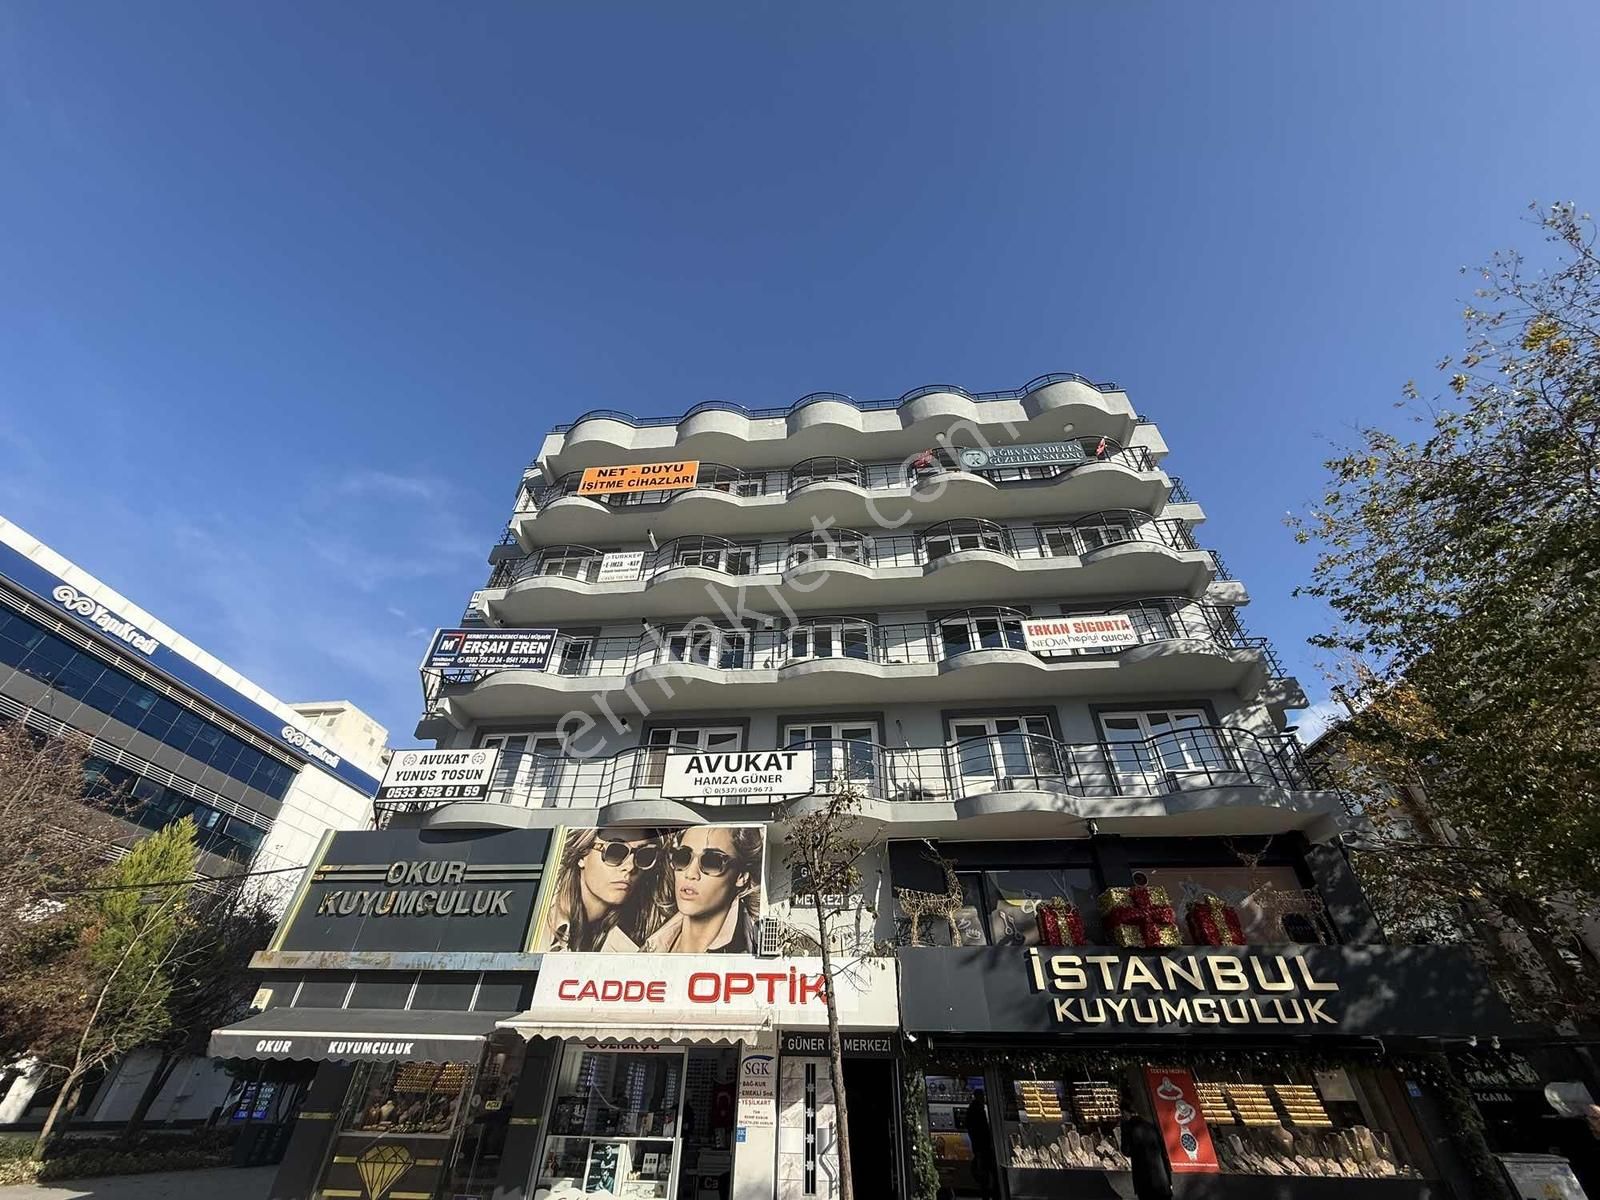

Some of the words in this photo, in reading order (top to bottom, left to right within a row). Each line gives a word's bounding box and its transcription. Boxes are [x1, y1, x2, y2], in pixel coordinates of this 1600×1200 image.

[597, 468, 628, 477] NET
[641, 464, 684, 474] DUYU
[581, 479, 624, 491] İŞİTME
[627, 475, 695, 487] CİHAZLARI
[1026, 623, 1070, 636] ERKAN
[1072, 619, 1130, 633] SİGORTA
[461, 641, 509, 656] ERŞAH
[510, 641, 548, 654] EREN
[419, 754, 469, 765] AVUKAT
[684, 752, 798, 774] AVUKAT
[395, 770, 437, 781] YUNUS
[441, 769, 484, 780] TOSUN
[694, 776, 738, 786] HAMZA
[741, 773, 783, 784] GÜNER
[386, 787, 417, 798] 0533
[419, 786, 443, 797] 352
[444, 786, 460, 797] 61
[463, 786, 480, 797] 59
[386, 860, 468, 885] OKUR
[316, 889, 514, 916] KUYUMCULUK
[1028, 947, 1340, 991] İSTANBUL
[558, 979, 667, 1002] CADDE
[687, 966, 828, 1005] OPTİK
[1053, 997, 1338, 1024] KUYUMCULUK
[255, 1040, 292, 1053] OKUR
[327, 1041, 414, 1055] KUYUMCULUK
[787, 1036, 825, 1051] GÜNER
[843, 1037, 892, 1052] MERKEZİ
[744, 1062, 770, 1075] SGK
